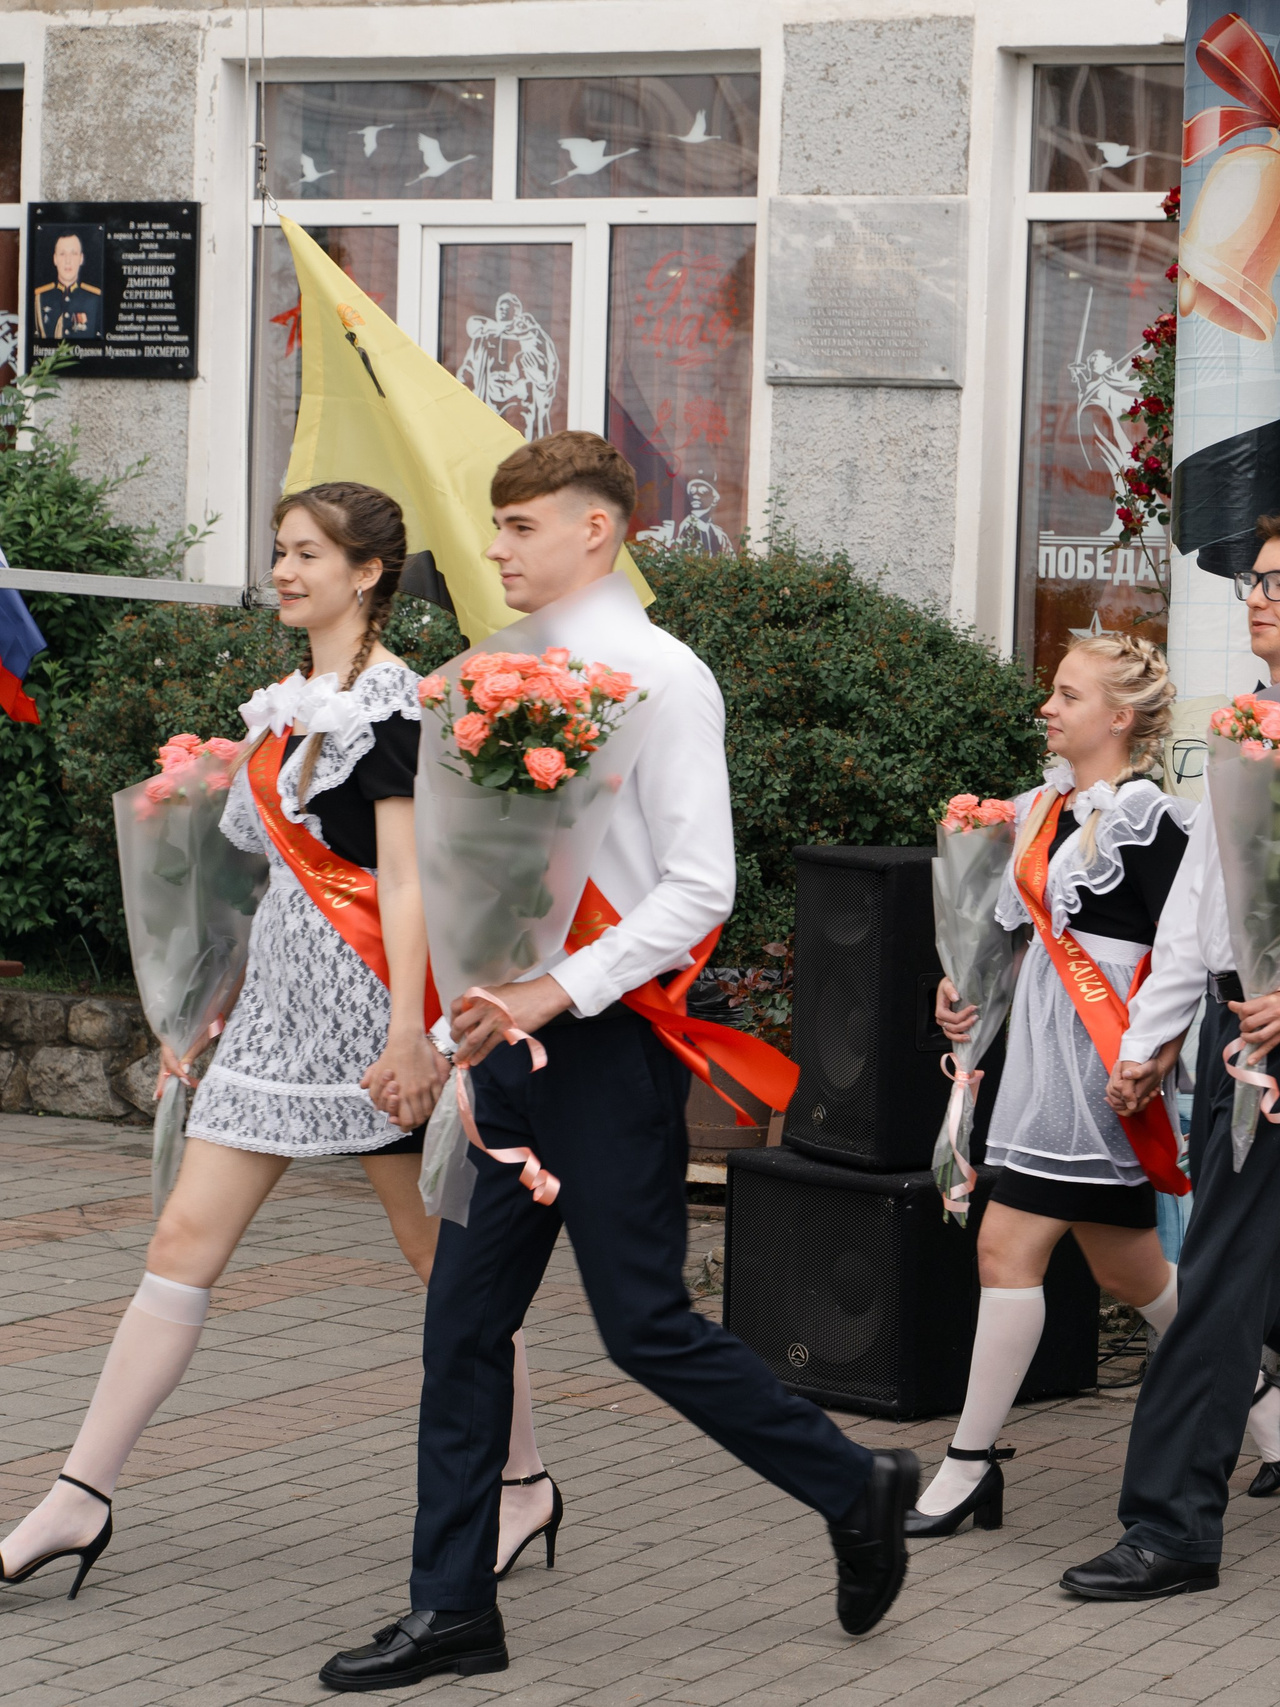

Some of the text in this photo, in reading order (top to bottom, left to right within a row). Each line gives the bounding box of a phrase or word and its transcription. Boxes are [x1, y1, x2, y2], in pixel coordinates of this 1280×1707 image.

[122, 265, 176, 277] ТЕРЕЩЕНКО
[126, 276, 170, 288] ДМИТРИЙ
[123, 289, 174, 300] СЕРГЕЕВИЧ
[144, 345, 191, 358] ПОСМЕРТНО
[1038, 545, 1167, 587] ПОБЕДА!
